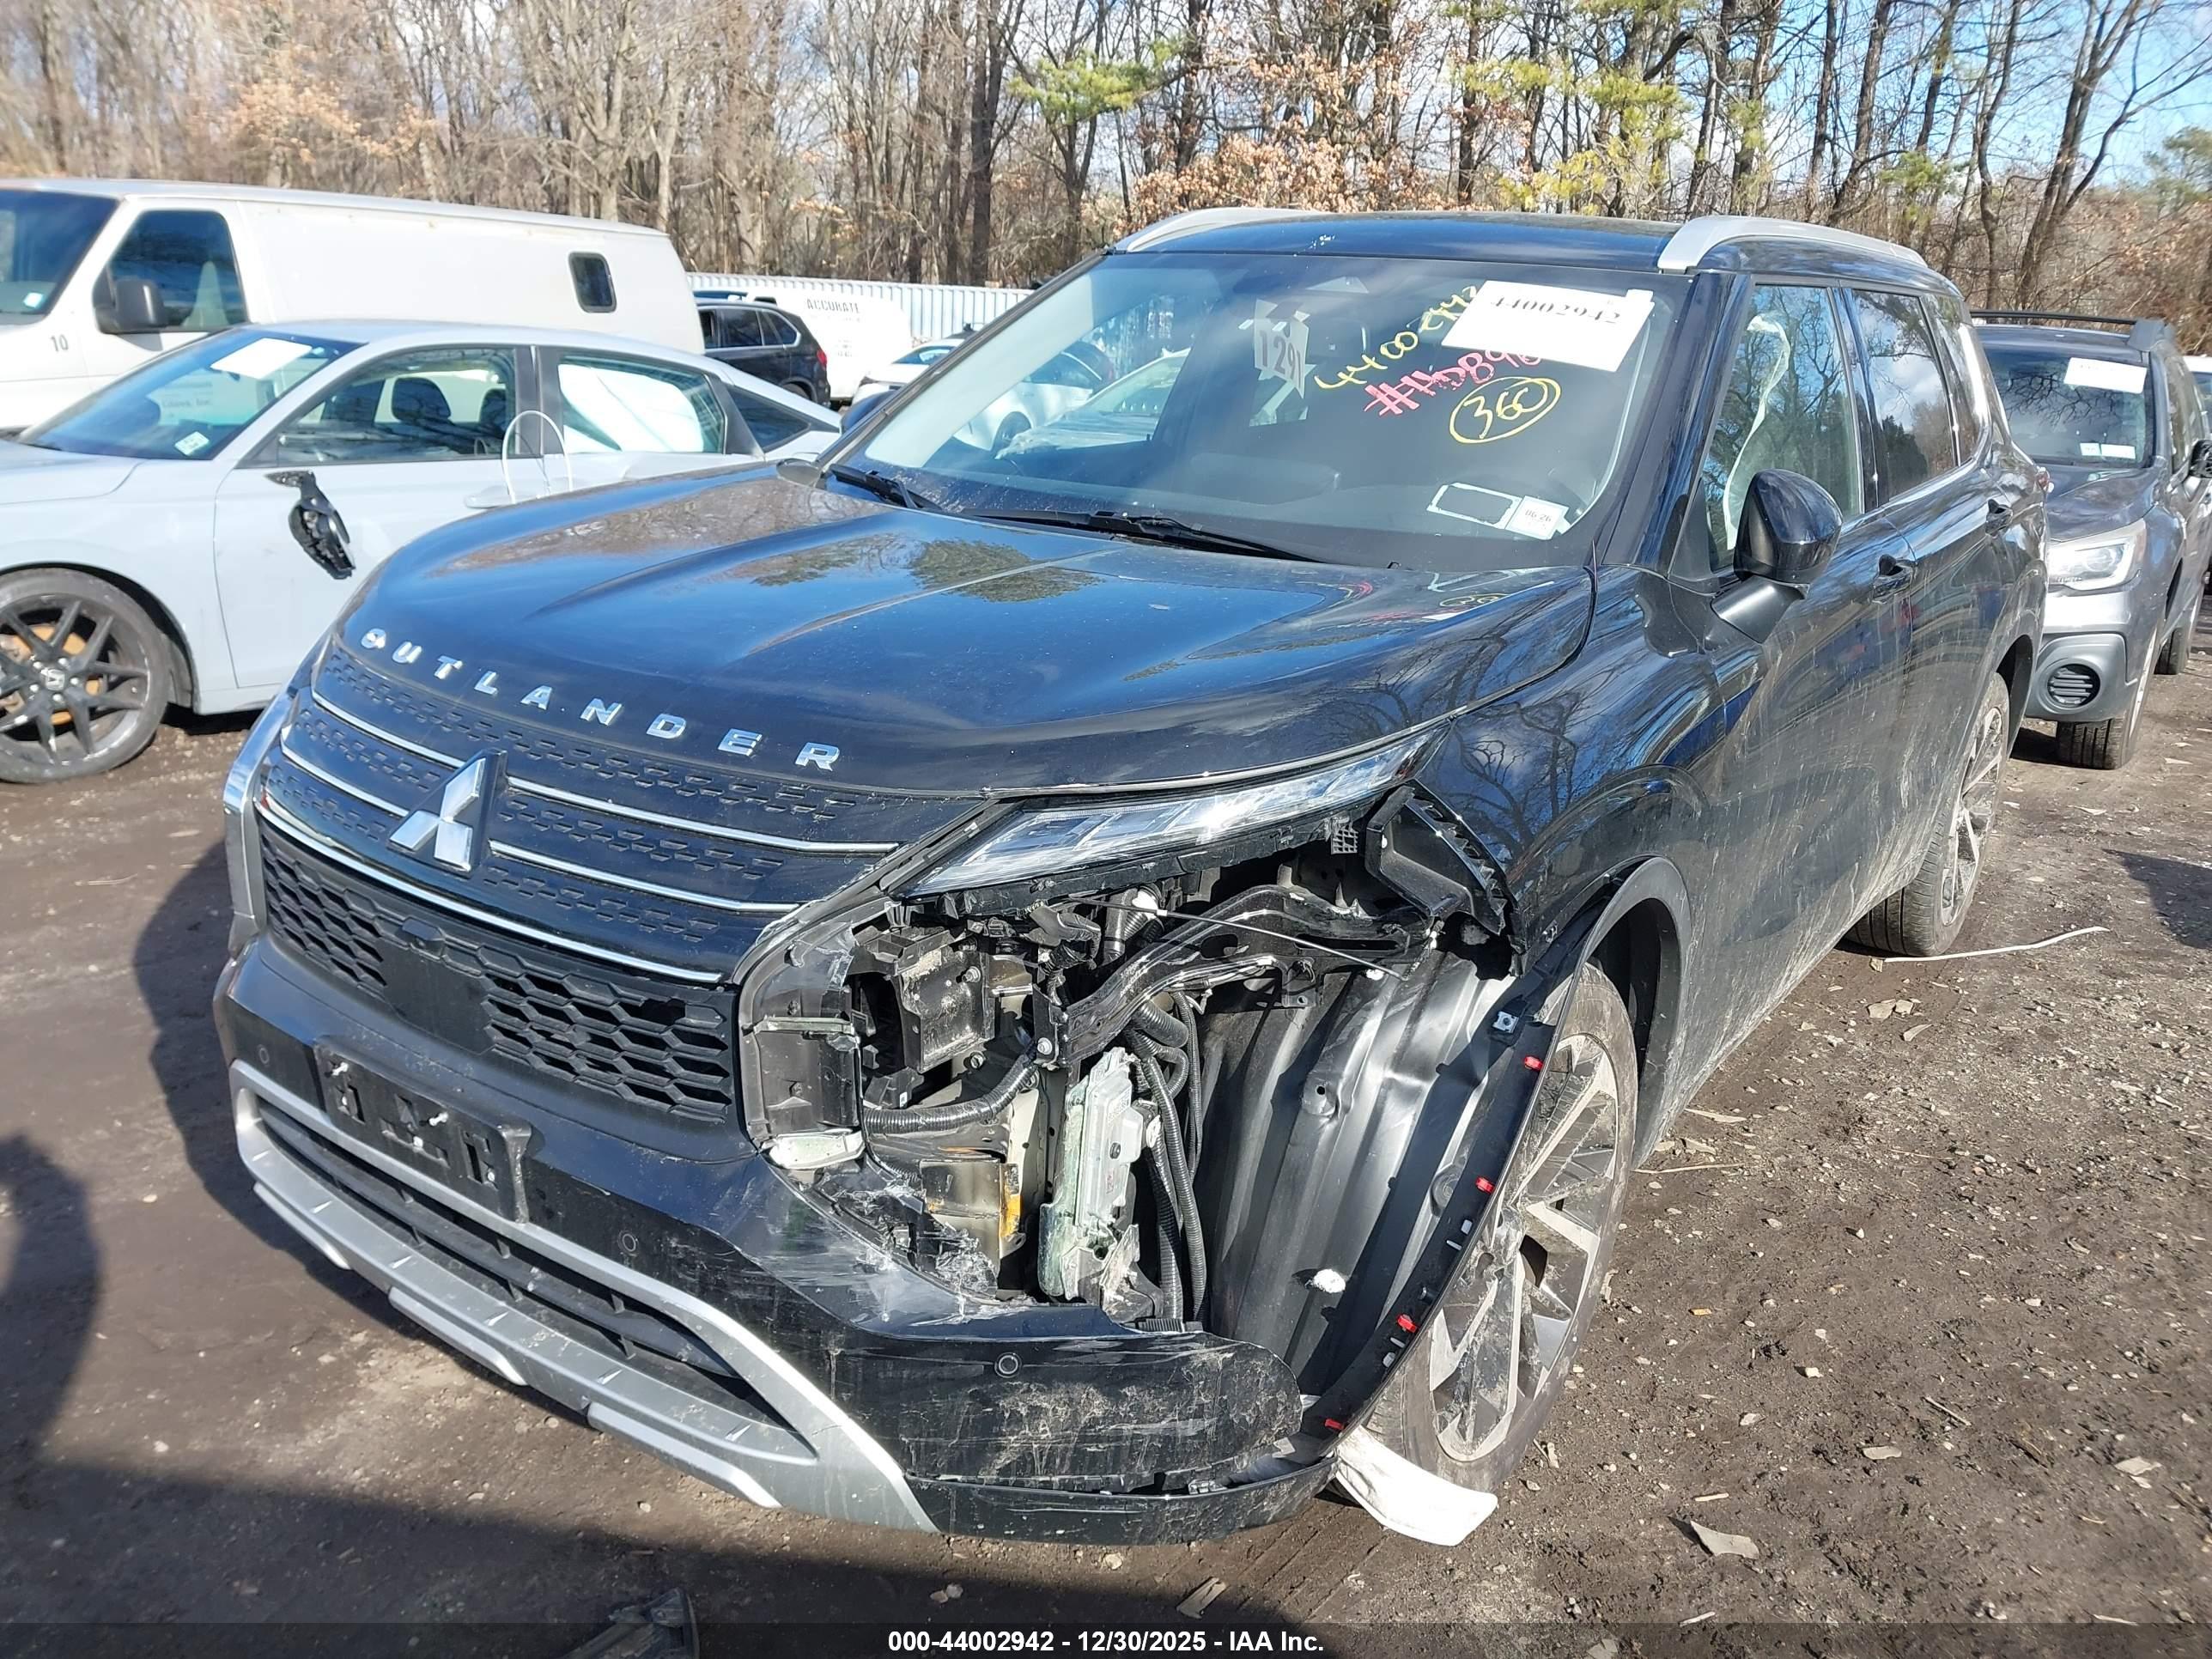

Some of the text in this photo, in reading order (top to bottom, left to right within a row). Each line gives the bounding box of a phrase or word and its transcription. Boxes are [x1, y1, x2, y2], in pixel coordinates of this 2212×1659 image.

[806, 297, 860, 314] ACCURATE
[1491, 297, 1620, 324] 44002942
[51, 334, 69, 352] 10
[360, 628, 842, 772] OUTLANDER
